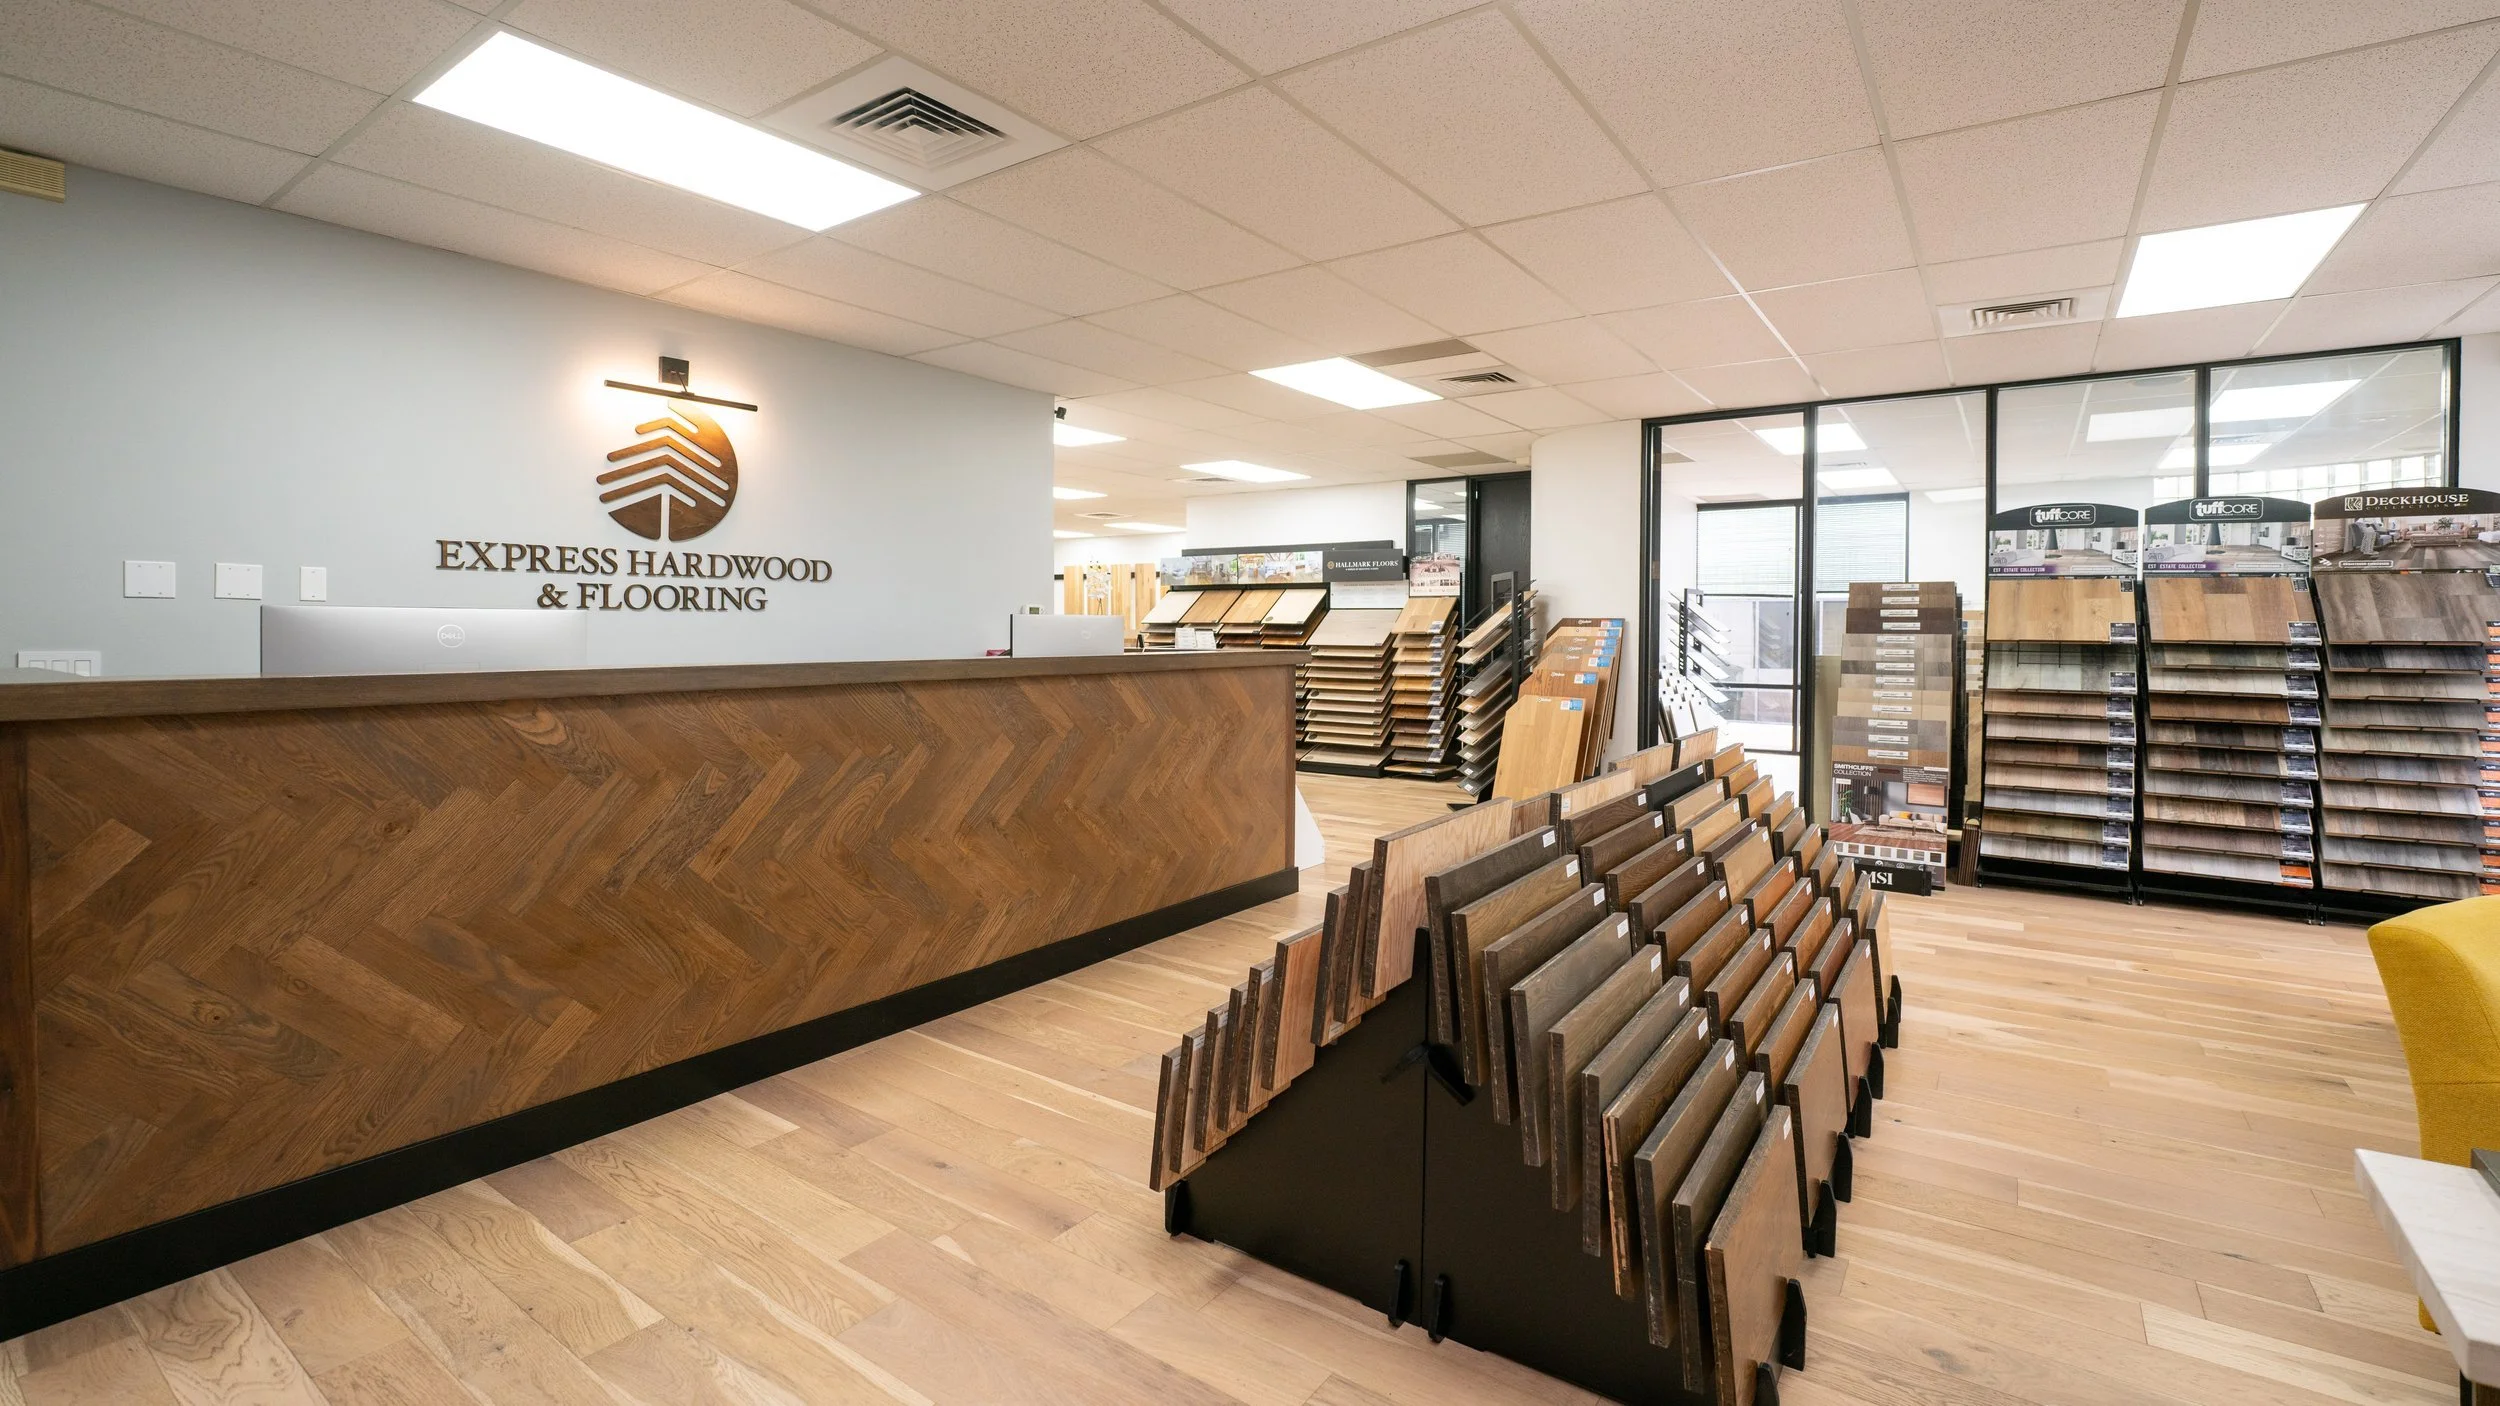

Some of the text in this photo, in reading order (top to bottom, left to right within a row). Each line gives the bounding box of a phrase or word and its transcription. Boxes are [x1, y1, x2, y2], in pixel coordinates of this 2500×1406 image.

[2366, 494, 2469, 506] DECKHOUSE
[435, 539, 833, 583] EXPRESS HARDWOOD
[1372, 560, 1399, 568] FLOORS
[537, 583, 769, 611] & FLOORING
[1833, 769, 1872, 777] COLLECTION
